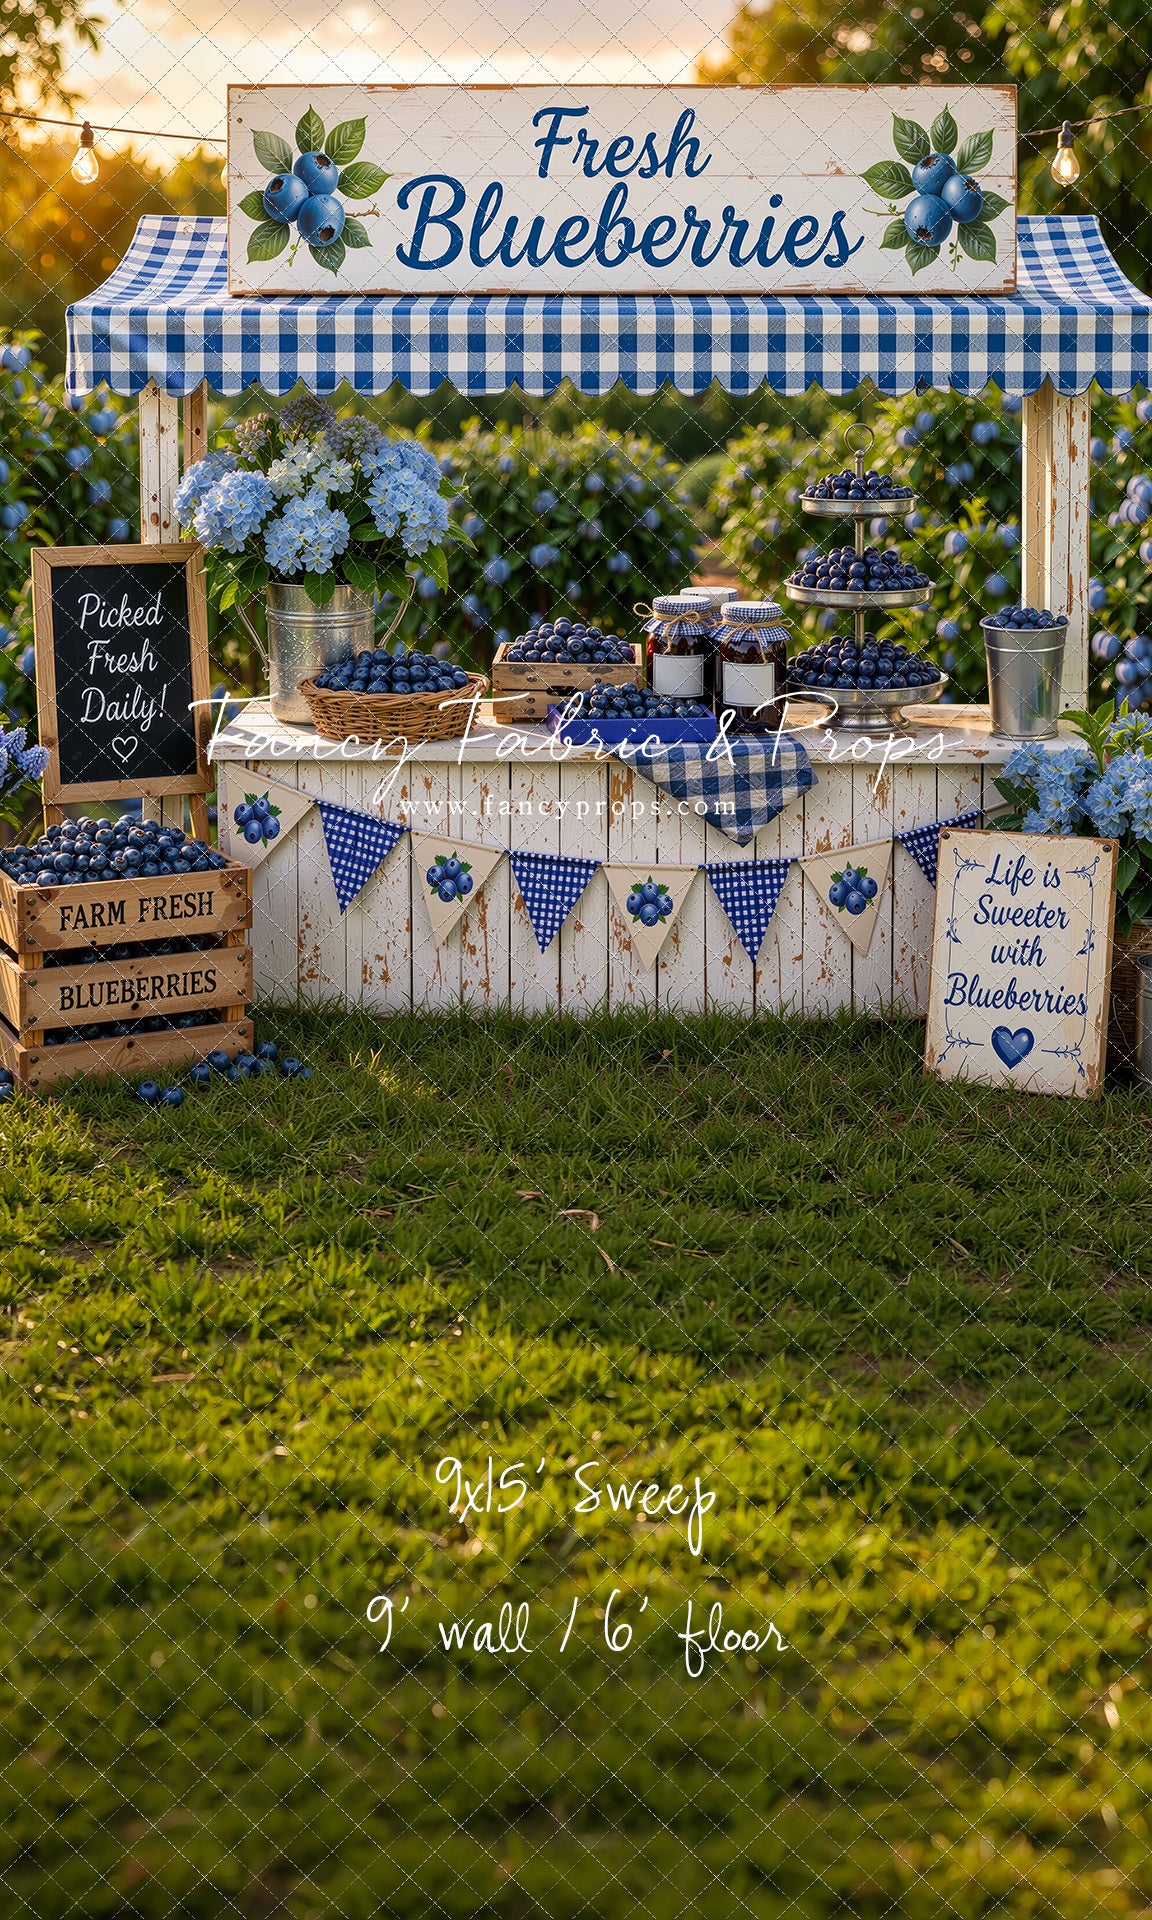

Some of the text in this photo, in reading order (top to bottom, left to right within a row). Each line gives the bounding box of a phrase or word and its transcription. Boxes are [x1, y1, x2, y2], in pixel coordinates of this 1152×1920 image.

[532, 105, 711, 179] Fresh
[395, 174, 864, 270] Blueberries
[78, 592, 163, 629] Picked
[87, 638, 158, 675] Fresh
[80, 684, 167, 732] Daily!
[985, 854, 1061, 896] Life is
[59, 891, 214, 931] FARM FRESH
[974, 894, 1070, 930] Sweeter
[991, 935, 1047, 967] with
[59, 969, 217, 1011] BLUEBERRIES
[944, 972, 1088, 1016] Blueberries
